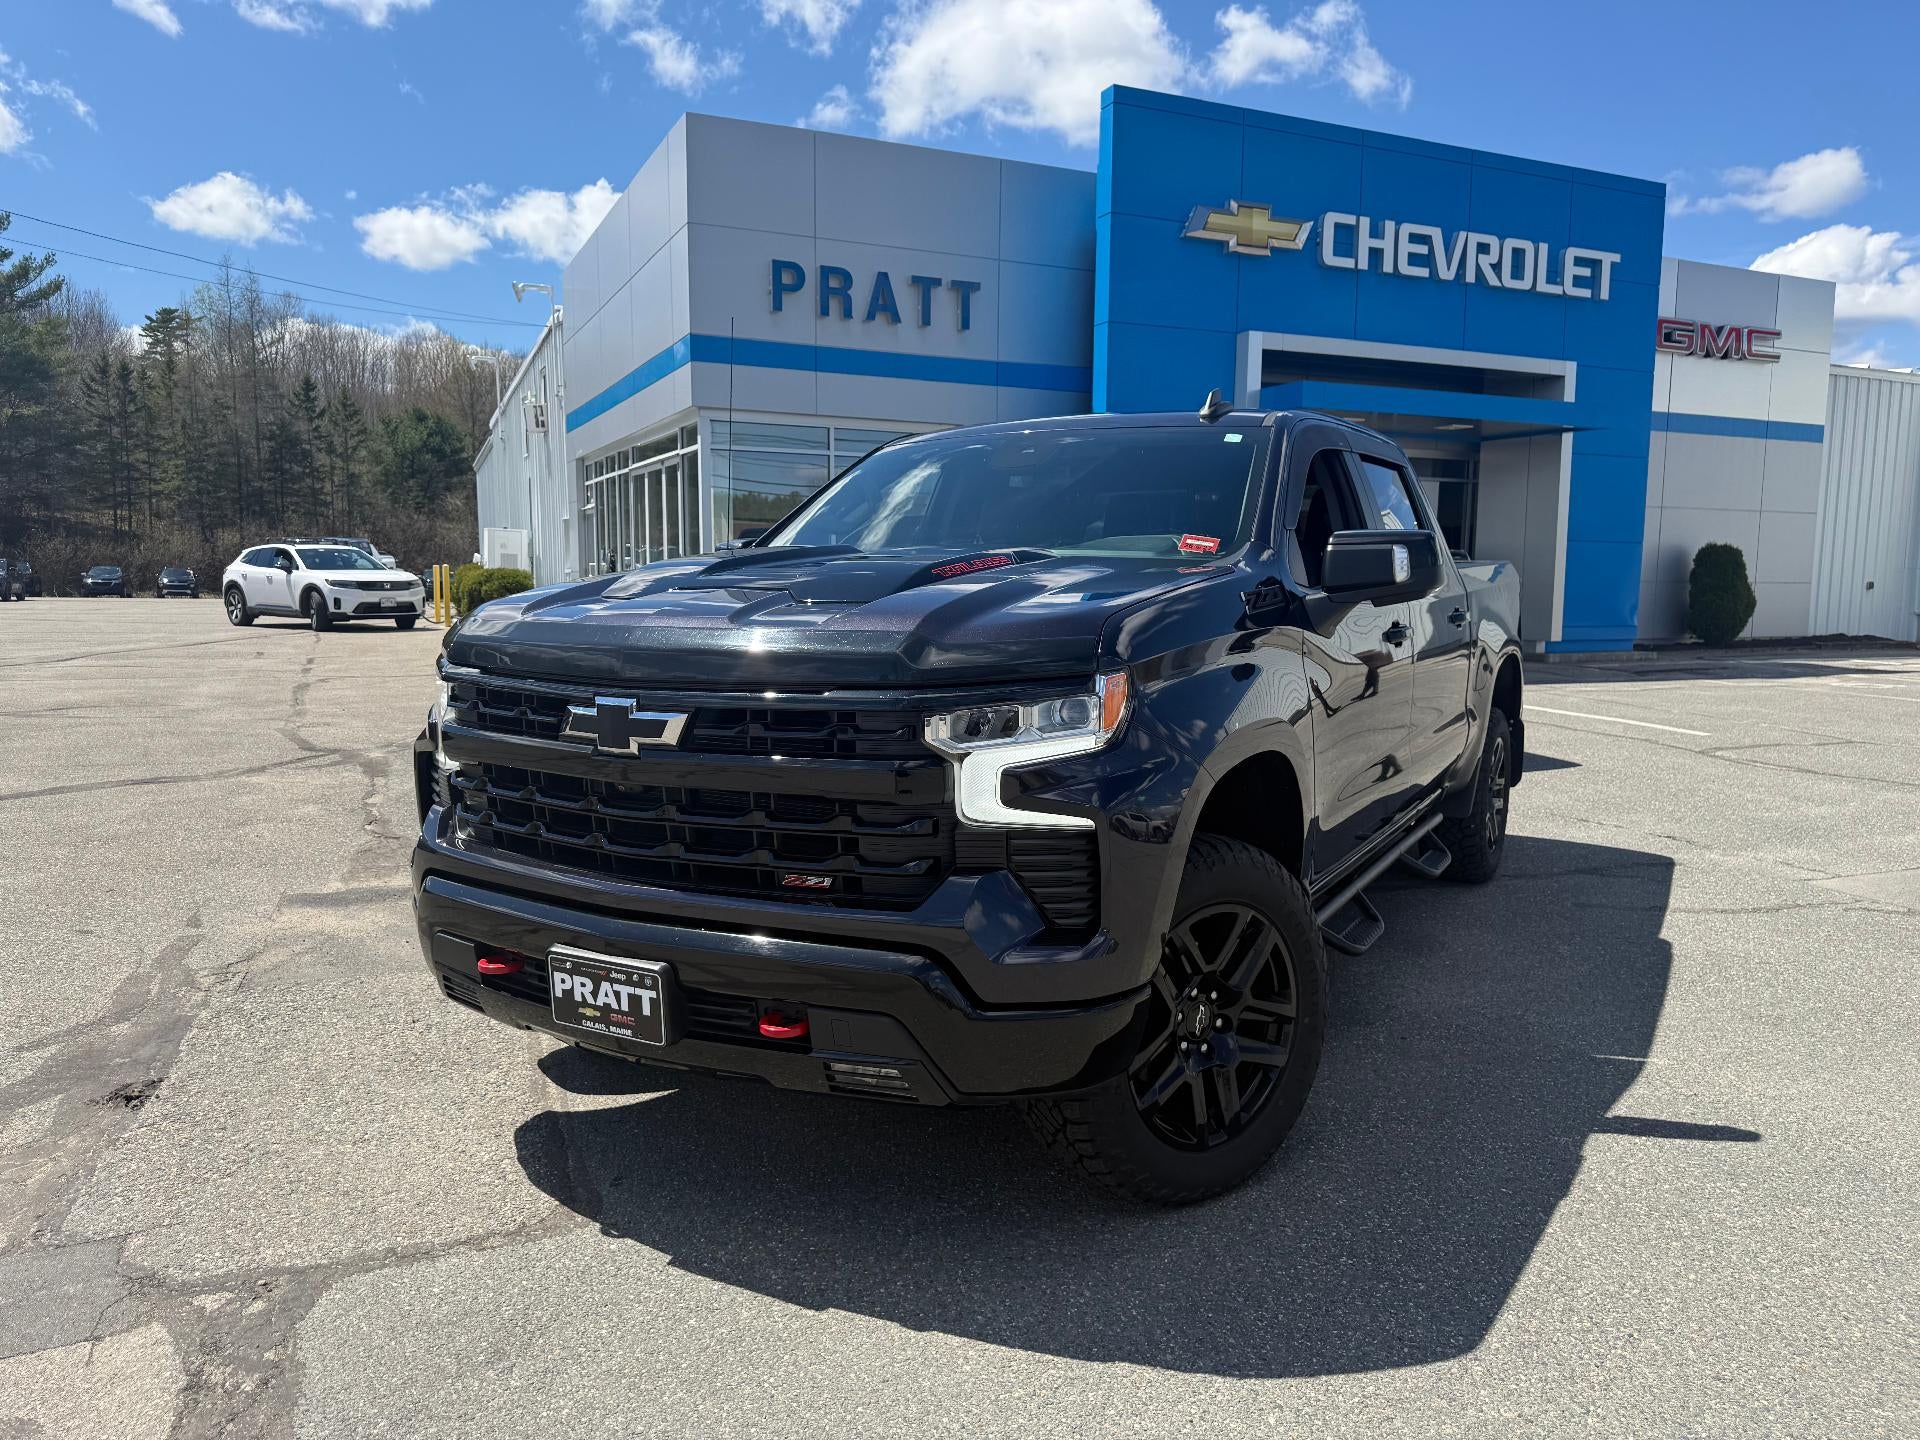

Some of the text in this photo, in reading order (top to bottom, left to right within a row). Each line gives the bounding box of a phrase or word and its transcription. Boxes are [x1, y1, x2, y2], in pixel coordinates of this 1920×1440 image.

[1322, 211, 1621, 300] CHEVROLET
[769, 258, 982, 331] PRATT
[1656, 317, 1782, 362] GMC
[782, 874, 833, 889] Z71
[609, 970, 627, 982] Jeep
[553, 971, 657, 1017] PRATT
[582, 1019, 633, 1037] CALAIS, MAINE
[610, 1013, 636, 1026] GMC
